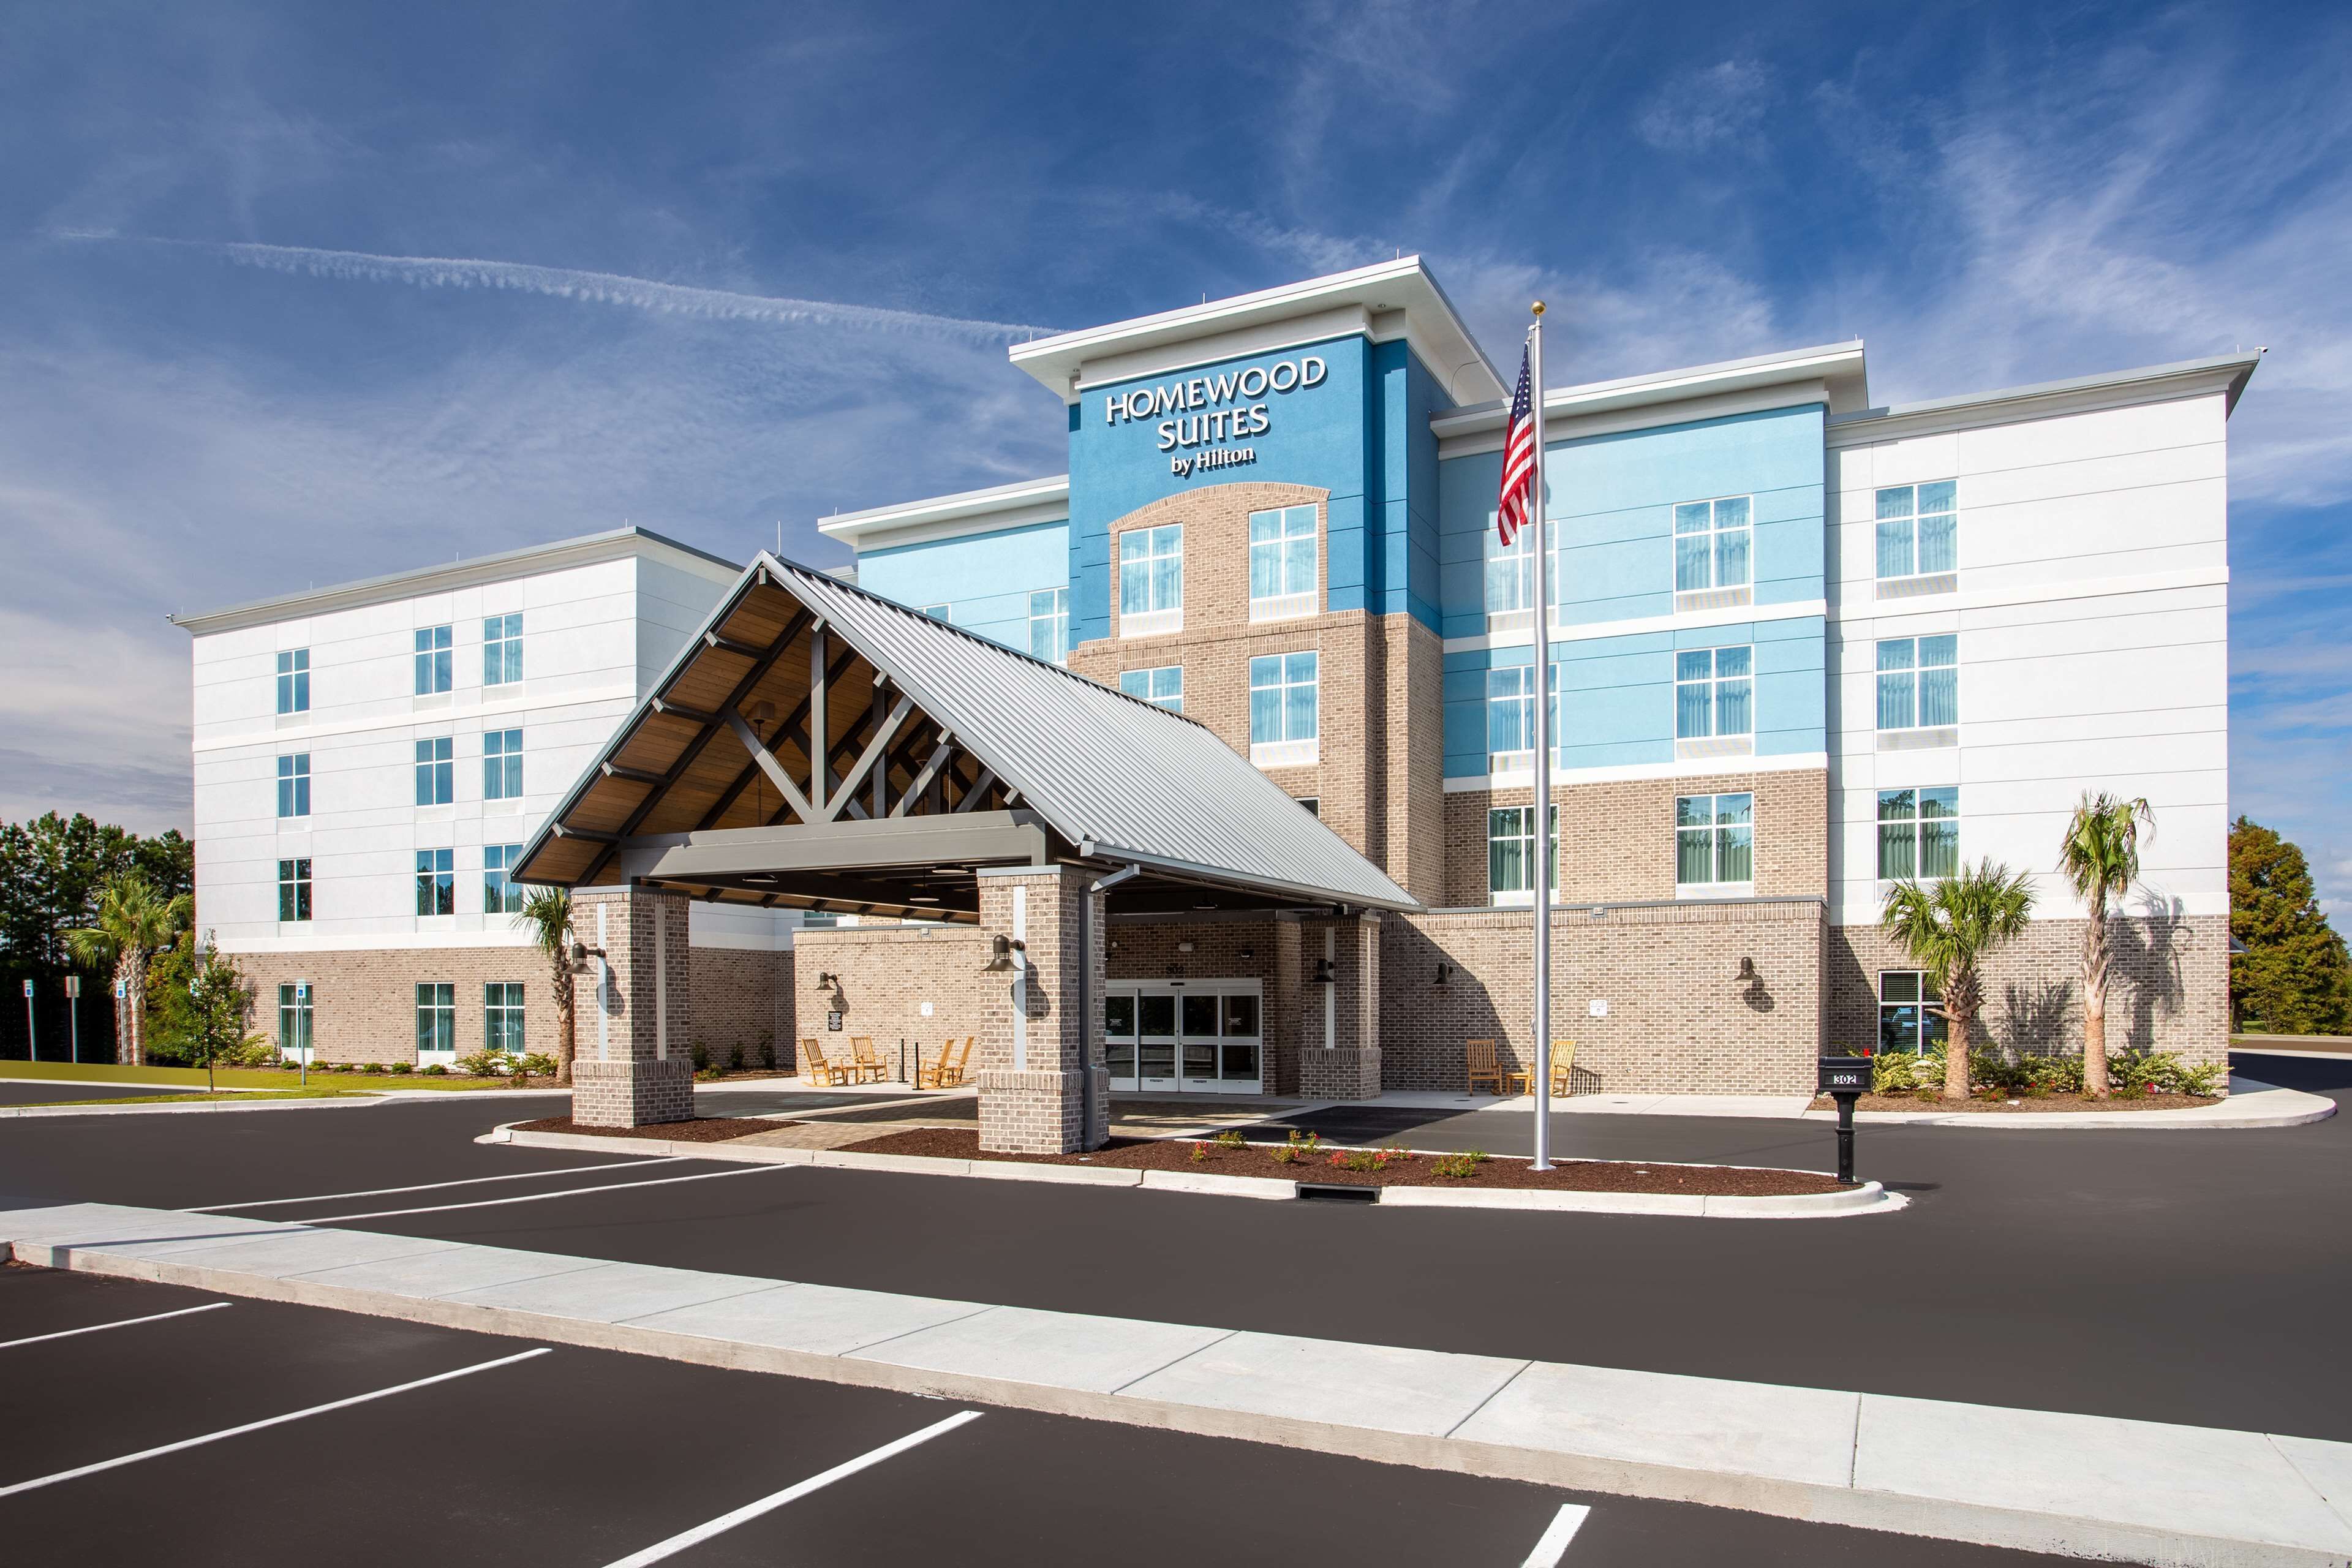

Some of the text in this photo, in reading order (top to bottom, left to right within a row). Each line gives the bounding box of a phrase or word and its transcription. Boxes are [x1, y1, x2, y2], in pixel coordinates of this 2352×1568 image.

[1106, 356, 1325, 423] HOMEWOOD
[1157, 404, 1269, 449] SUITES
[1171, 447, 1254, 475] by Hilton
[1166, 966, 1185, 974] 302
[1834, 1074, 1855, 1084] 302
